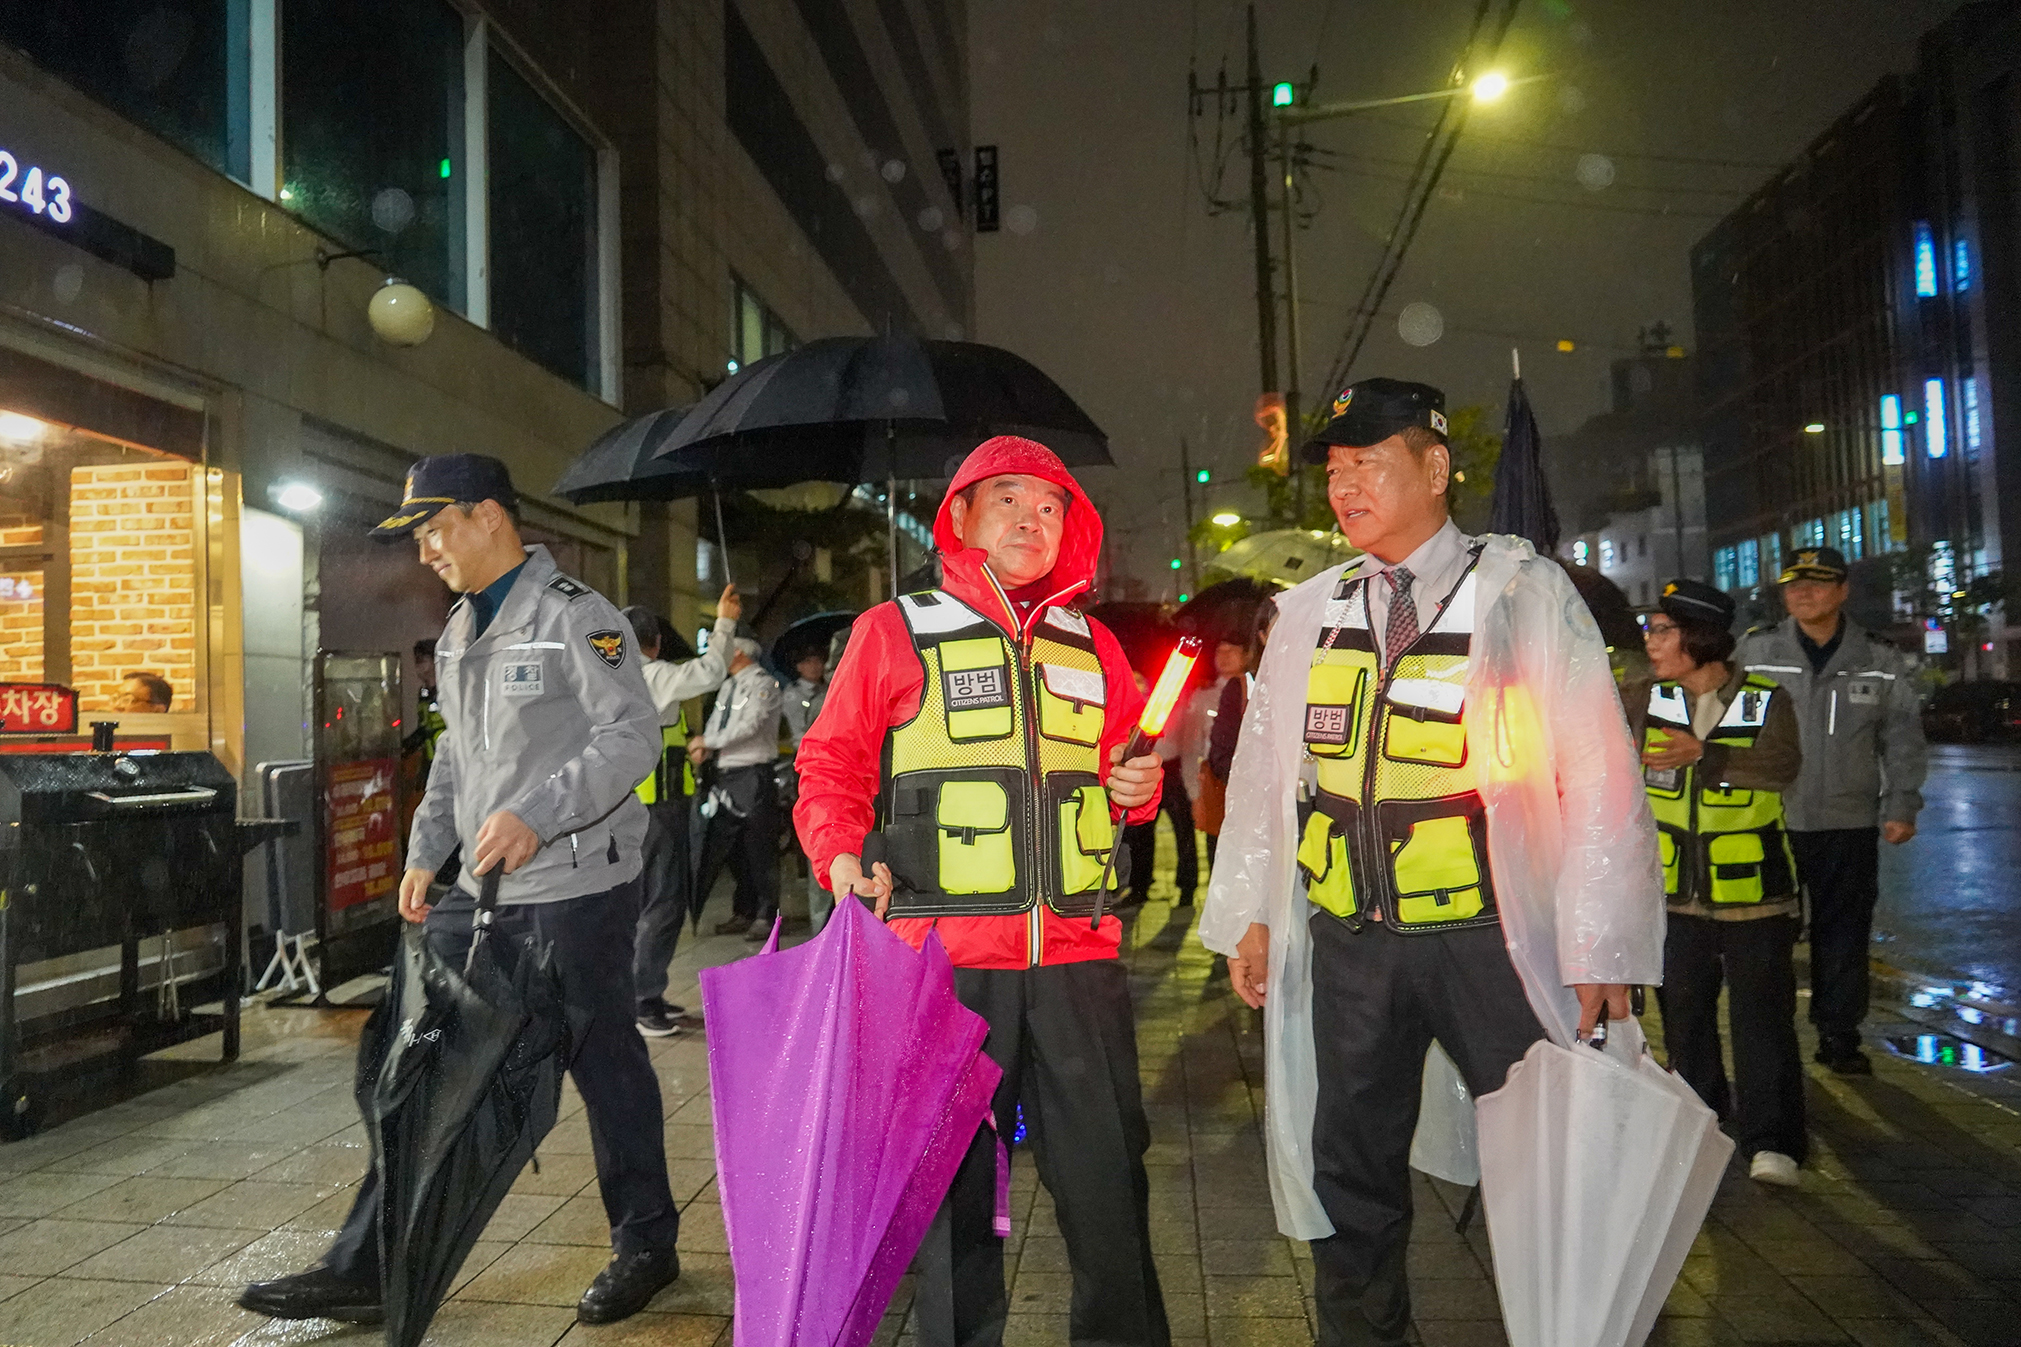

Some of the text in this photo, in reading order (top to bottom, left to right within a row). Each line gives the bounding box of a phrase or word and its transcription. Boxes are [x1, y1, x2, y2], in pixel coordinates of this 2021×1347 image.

[505, 683, 540, 691] POLICE
[954, 671, 996, 695] 방범
[0, 689, 63, 725] 차장
[952, 695, 1004, 707] CITIZENS PATROL
[1313, 709, 1343, 730] 방범
